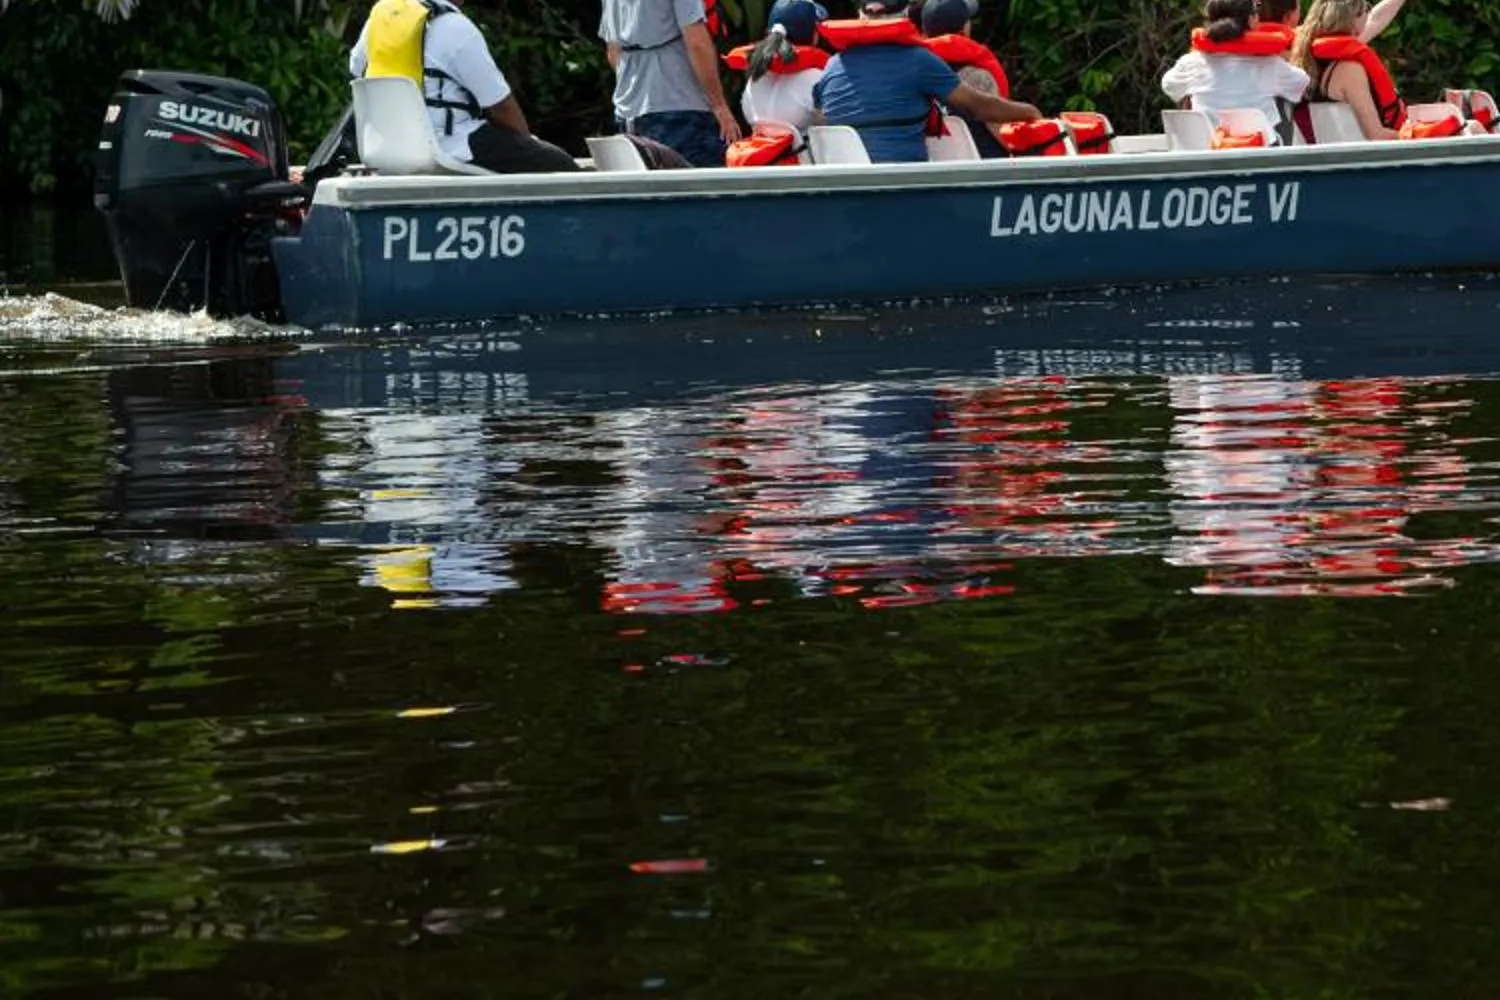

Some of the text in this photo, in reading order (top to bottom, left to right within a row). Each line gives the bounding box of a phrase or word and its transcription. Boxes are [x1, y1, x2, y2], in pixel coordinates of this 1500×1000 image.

[158, 101, 260, 137] SUZUKI
[1268, 181, 1300, 222] VI
[383, 214, 525, 261] PL2516
